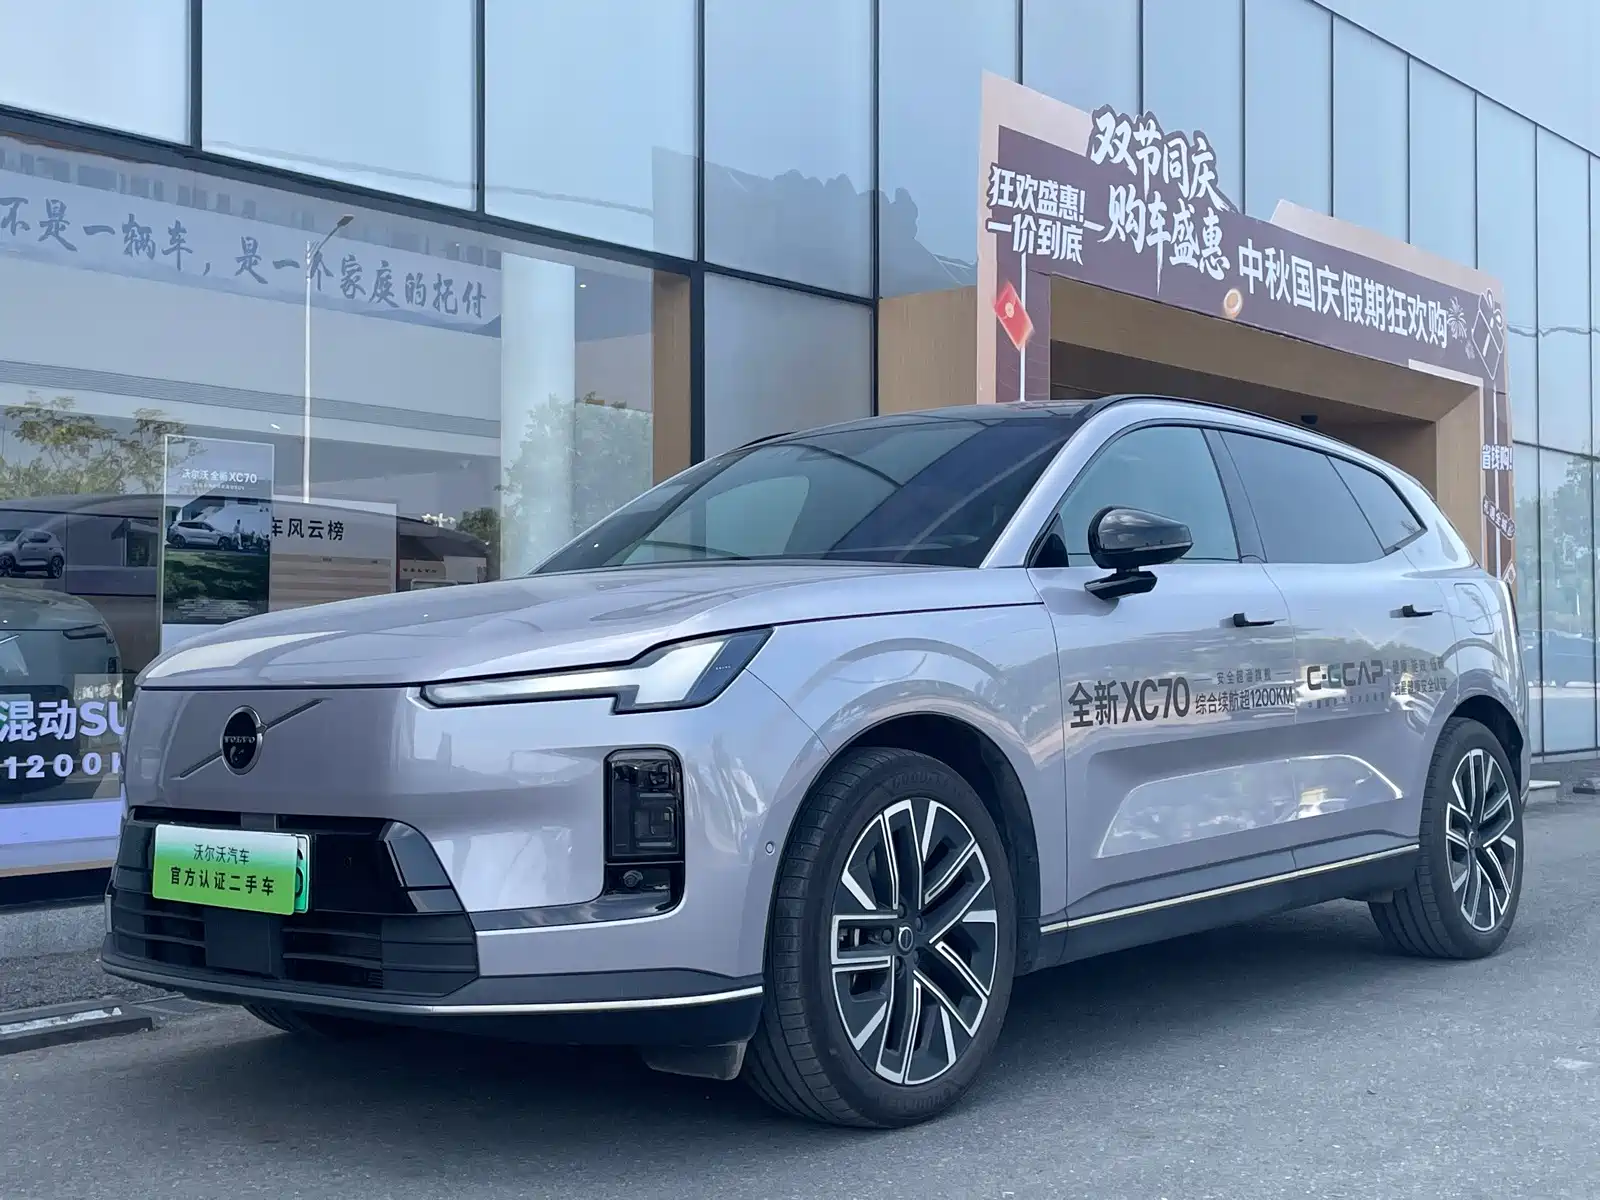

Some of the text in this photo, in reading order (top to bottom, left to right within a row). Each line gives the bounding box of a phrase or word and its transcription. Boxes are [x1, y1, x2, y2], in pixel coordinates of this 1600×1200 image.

[1091, 111, 1231, 212] 双节同庆
[989, 166, 1086, 223] 狂欢盛惠!
[988, 214, 1084, 266] 一价到底
[1097, 184, 1231, 296] 购车盛惠
[1238, 238, 1448, 349] 中秋国庆假期狂欢购
[1068, 677, 1191, 728] 全新XC70
[224, 735, 256, 743] VOLVO
[193, 844, 250, 865] 沃尔沃汽车
[170, 866, 275, 897] 官方认证二手车
